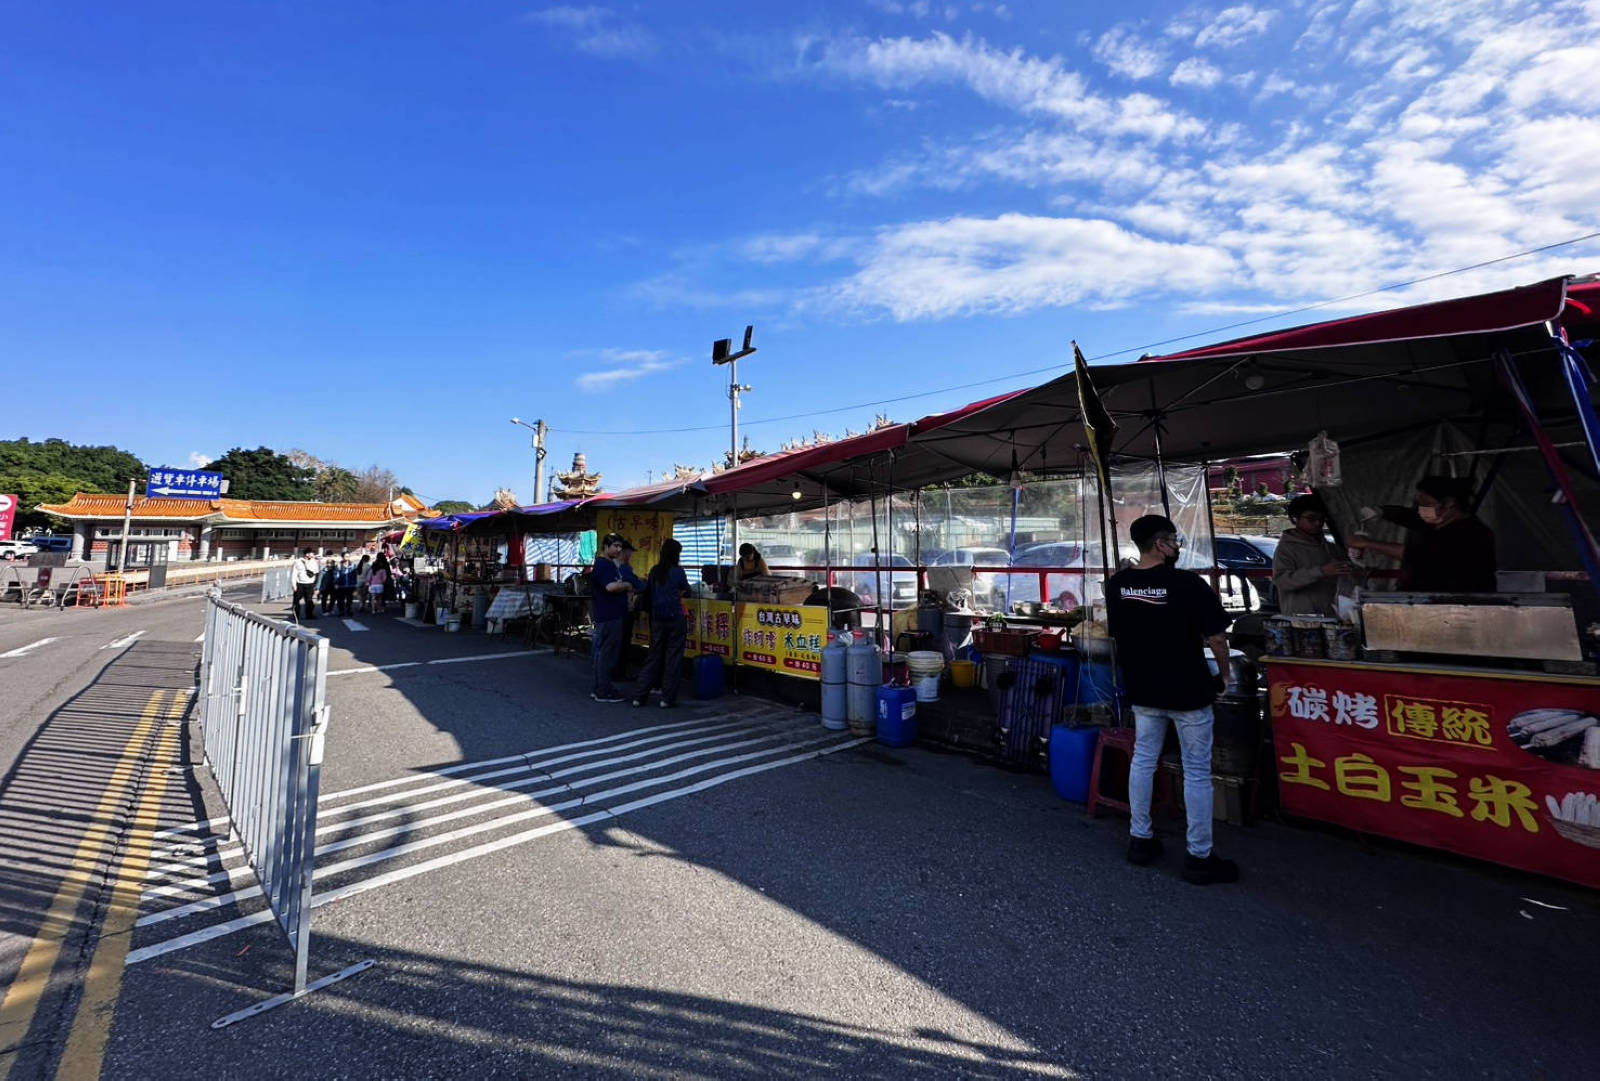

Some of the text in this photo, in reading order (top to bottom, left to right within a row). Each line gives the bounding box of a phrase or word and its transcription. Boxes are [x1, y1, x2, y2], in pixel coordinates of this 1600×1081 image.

[150, 471, 219, 488] 遊覽車停車場
[1119, 585, 1167, 597] Balenciaga
[757, 609, 802, 627] 台灣古早味
[784, 631, 822, 652] 米血糕
[1287, 686, 1495, 746] 碳烤 傳統
[1280, 742, 1540, 833] 土白玉米
